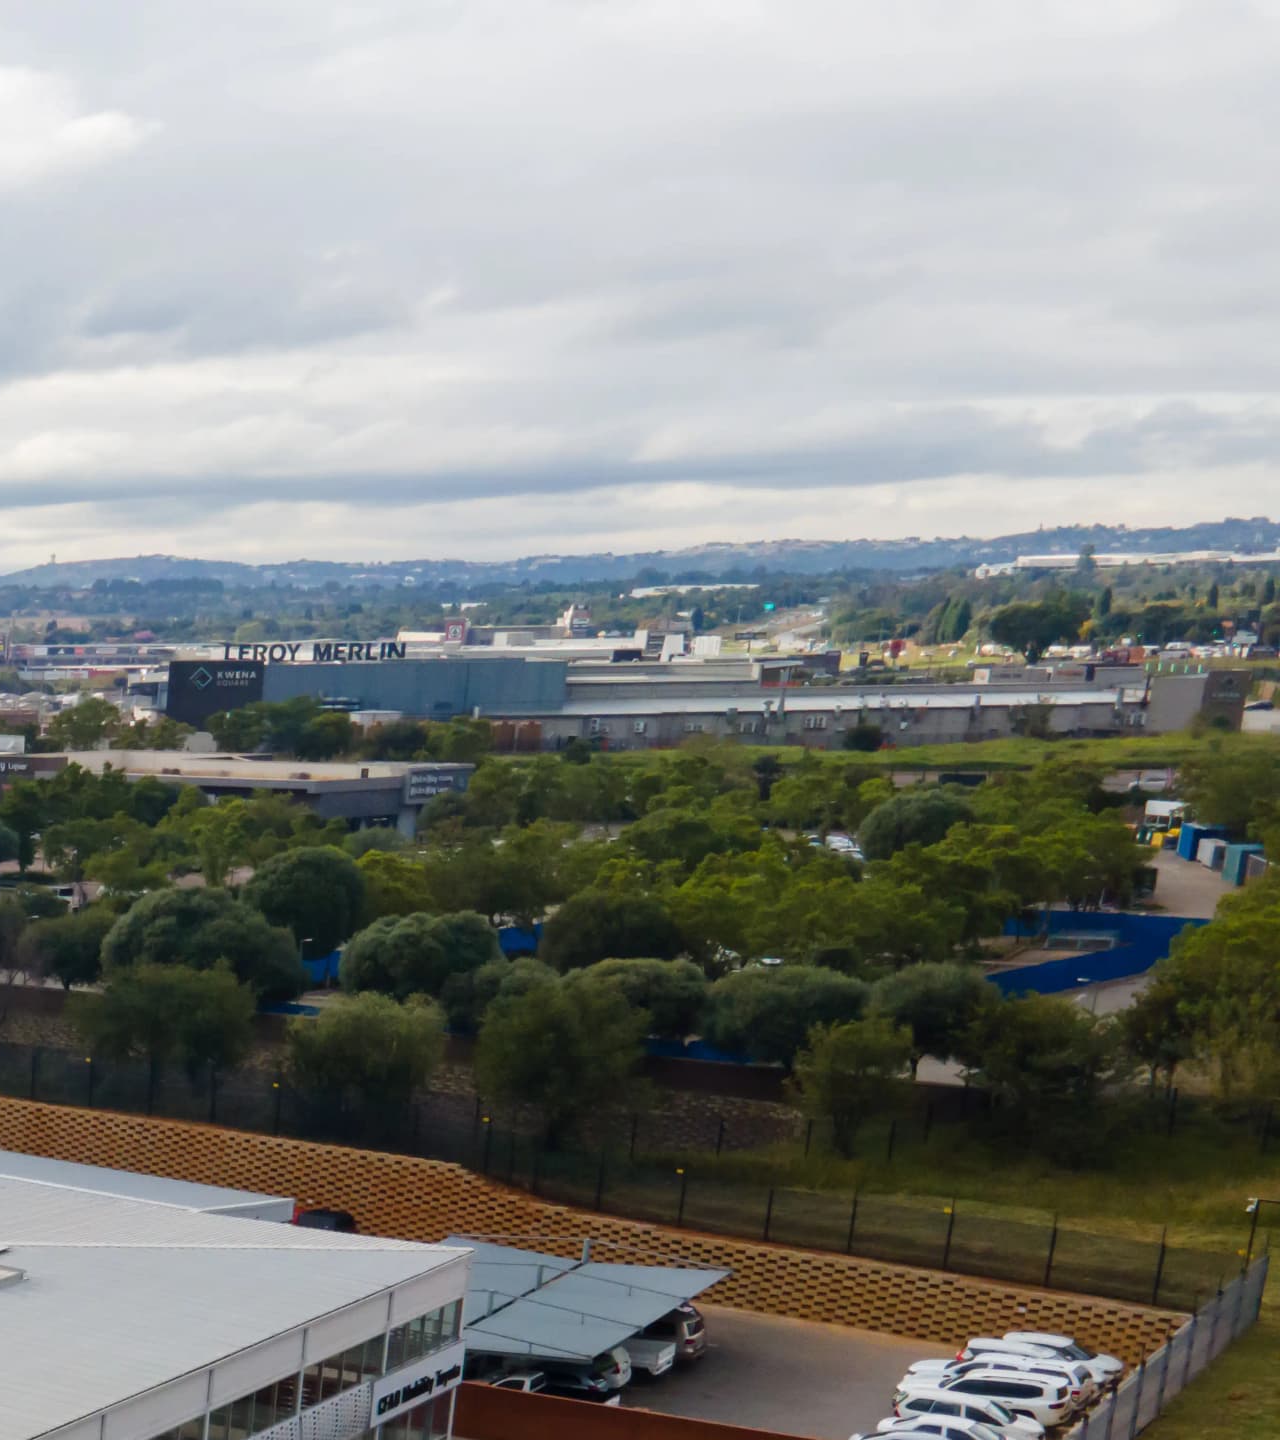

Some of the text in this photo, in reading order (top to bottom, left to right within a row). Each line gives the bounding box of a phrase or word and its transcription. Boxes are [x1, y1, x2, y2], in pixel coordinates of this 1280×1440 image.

[224, 642, 407, 662] LEROY MERLIN
[217, 671, 257, 679] KWENA
